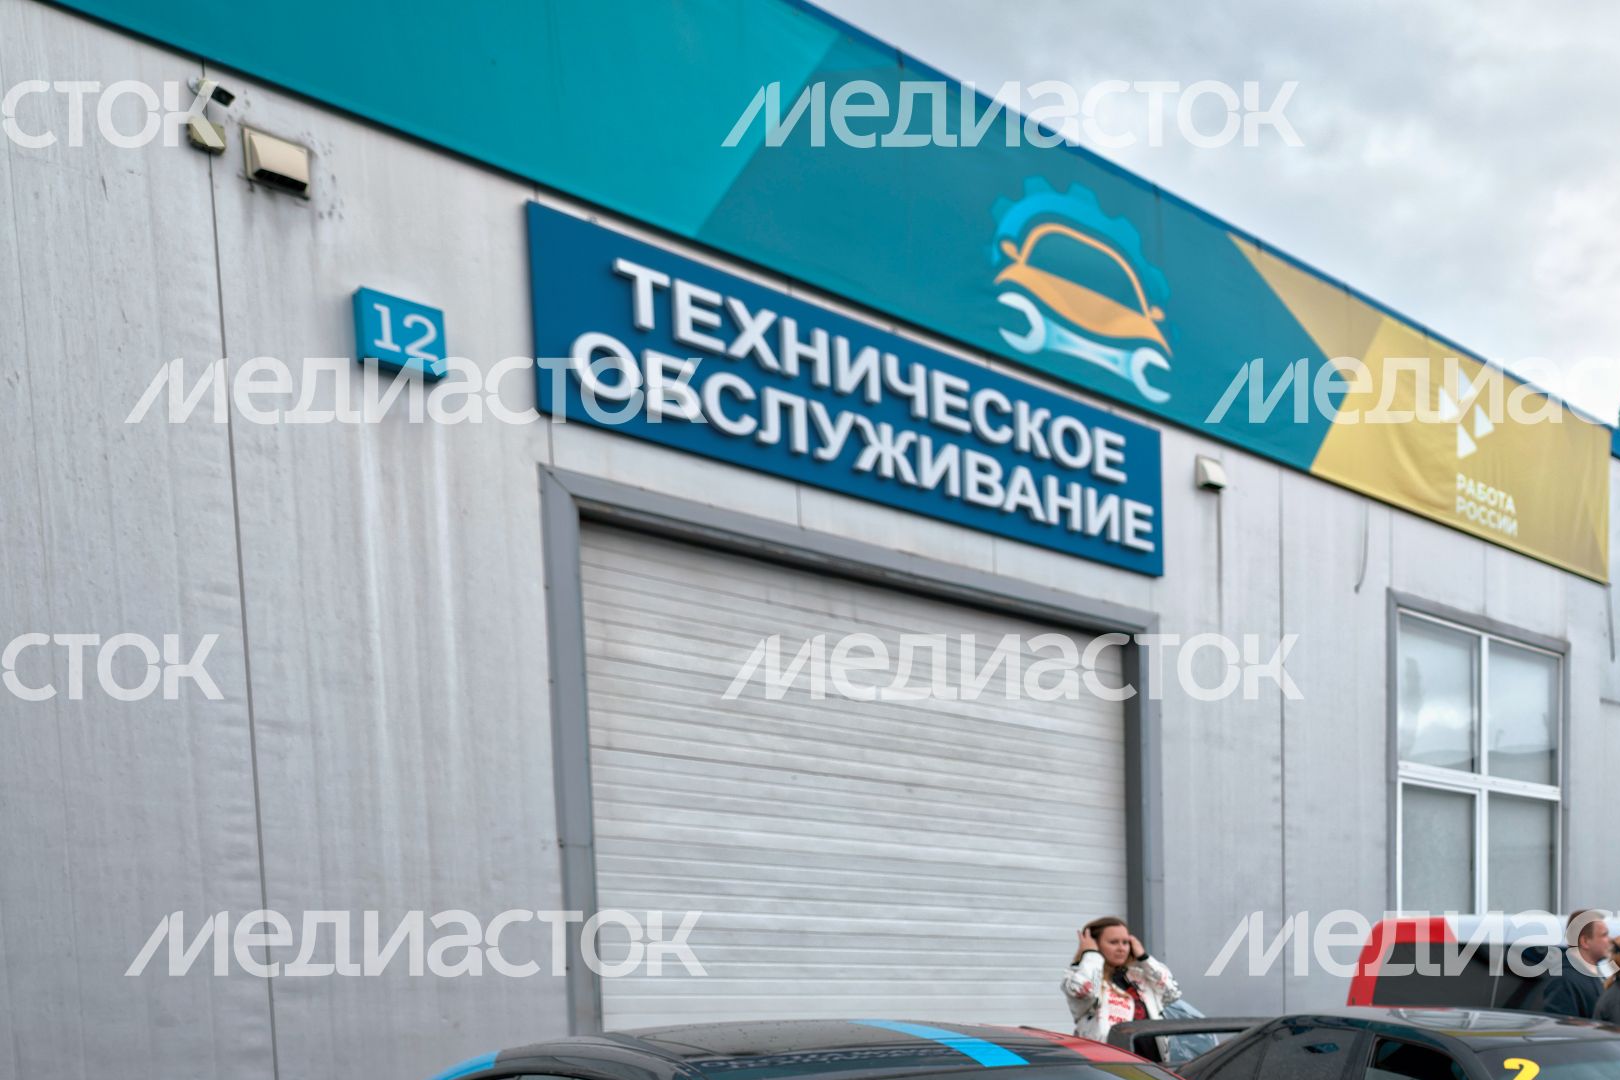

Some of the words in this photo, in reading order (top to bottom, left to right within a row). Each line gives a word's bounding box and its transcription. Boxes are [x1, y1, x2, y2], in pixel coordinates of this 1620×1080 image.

[371, 302, 442, 364] 12
[613, 257, 1127, 484] ТЕХНИЧЕСКОЕ
[568, 330, 1156, 554] ОБСЛУЖИВАНИЕ
[1456, 473, 1517, 513] РАБОТА
[1456, 495, 1518, 537] РОССИИ
